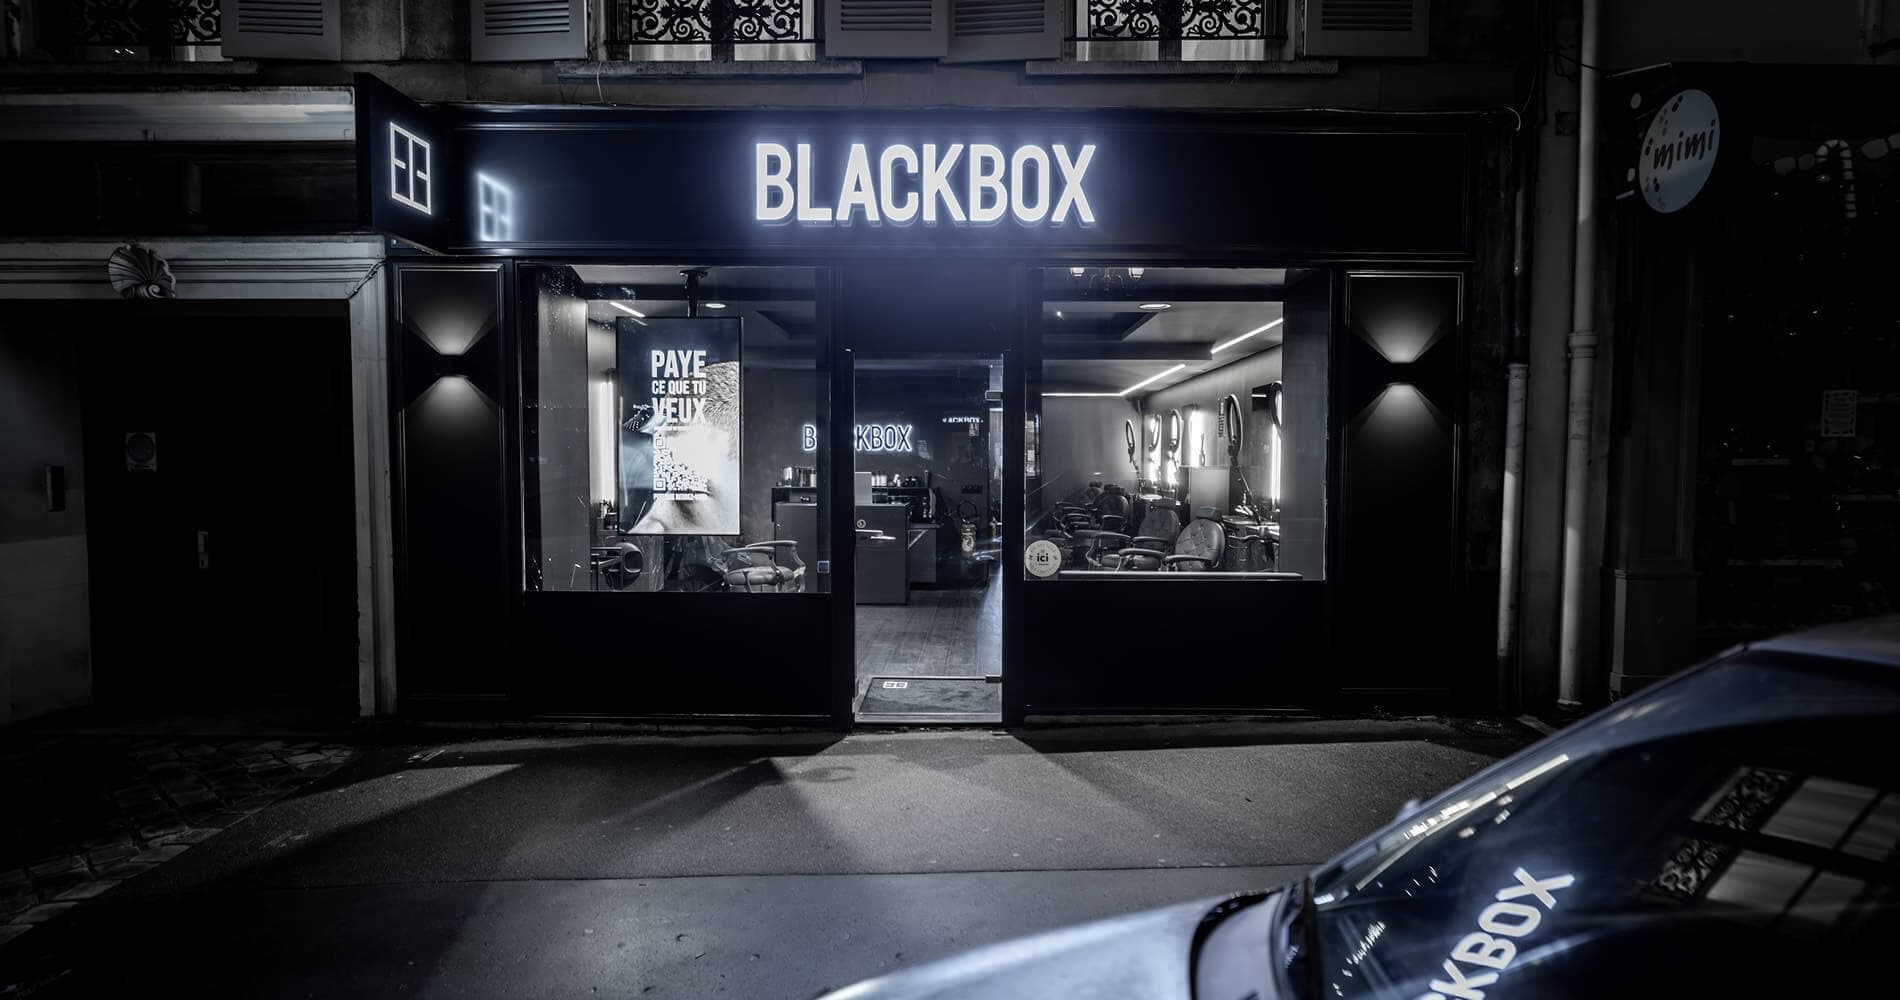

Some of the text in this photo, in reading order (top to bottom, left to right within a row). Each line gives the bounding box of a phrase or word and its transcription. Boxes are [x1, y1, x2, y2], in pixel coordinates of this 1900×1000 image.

[1653, 118, 1716, 170] mimi
[756, 143, 1096, 222] BLACKBOX
[651, 350, 707, 378] PAYE
[652, 380, 707, 395] CE QUE TU
[651, 397, 707, 423] VEUX
[1036, 553, 1049, 562] ici
